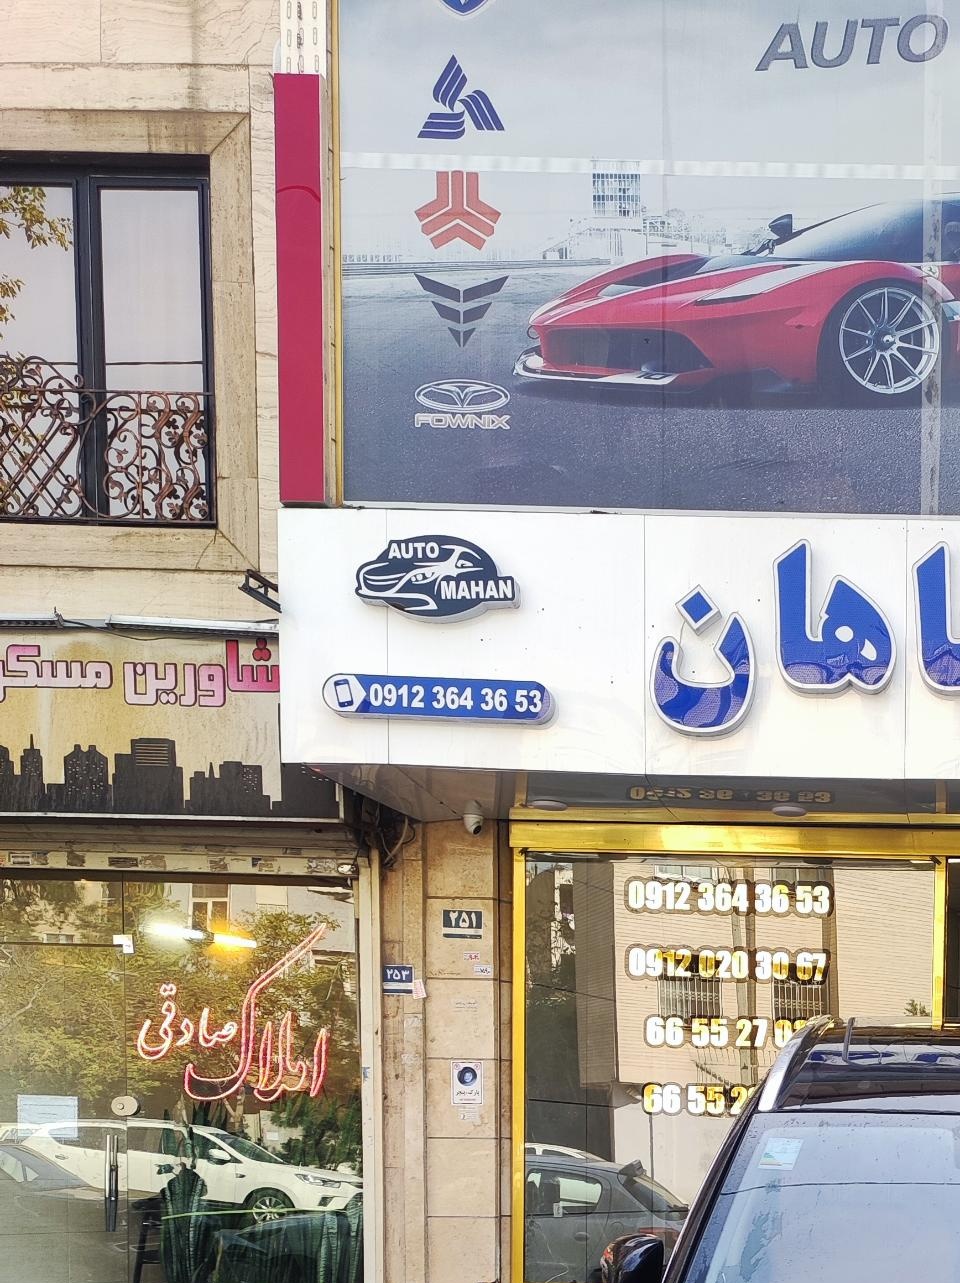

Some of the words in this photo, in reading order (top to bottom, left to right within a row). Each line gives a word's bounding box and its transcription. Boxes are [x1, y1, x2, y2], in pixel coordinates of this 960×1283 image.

[755, 14, 949, 71] AUTO
[415, 413, 511, 429] FOWNIX
[388, 542, 439, 559] AUTO
[440, 580, 513, 599] MAHAN
[0, 644, 113, 700] مسک
[123, 638, 280, 707] شاورین
[369, 683, 425, 708] 0912
[432, 685, 473, 710] 364
[481, 687, 508, 711] 36
[515, 690, 542, 712] 53
[628, 880, 691, 910] 0912
[697, 882, 749, 912] 364
[754, 883, 789, 913] 36
[795, 885, 830, 914] 53
[449, 911, 477, 928] ۲۵۱
[386, 968, 410, 980] ۲۵۳
[628, 947, 691, 978] 0912
[698, 949, 749, 979] 020
[755, 951, 789, 980] 30
[796, 951, 827, 981] 67
[137, 982, 238, 1060] صادقی
[185, 923, 329, 1101] املاک
[646, 1016, 684, 1047] 66
[691, 1018, 729, 1047] 55
[735, 1018, 768, 1047] 27
[643, 1084, 681, 1114] 66
[687, 1086, 725, 1115] 55
[730, 1086, 755, 1115] 2
